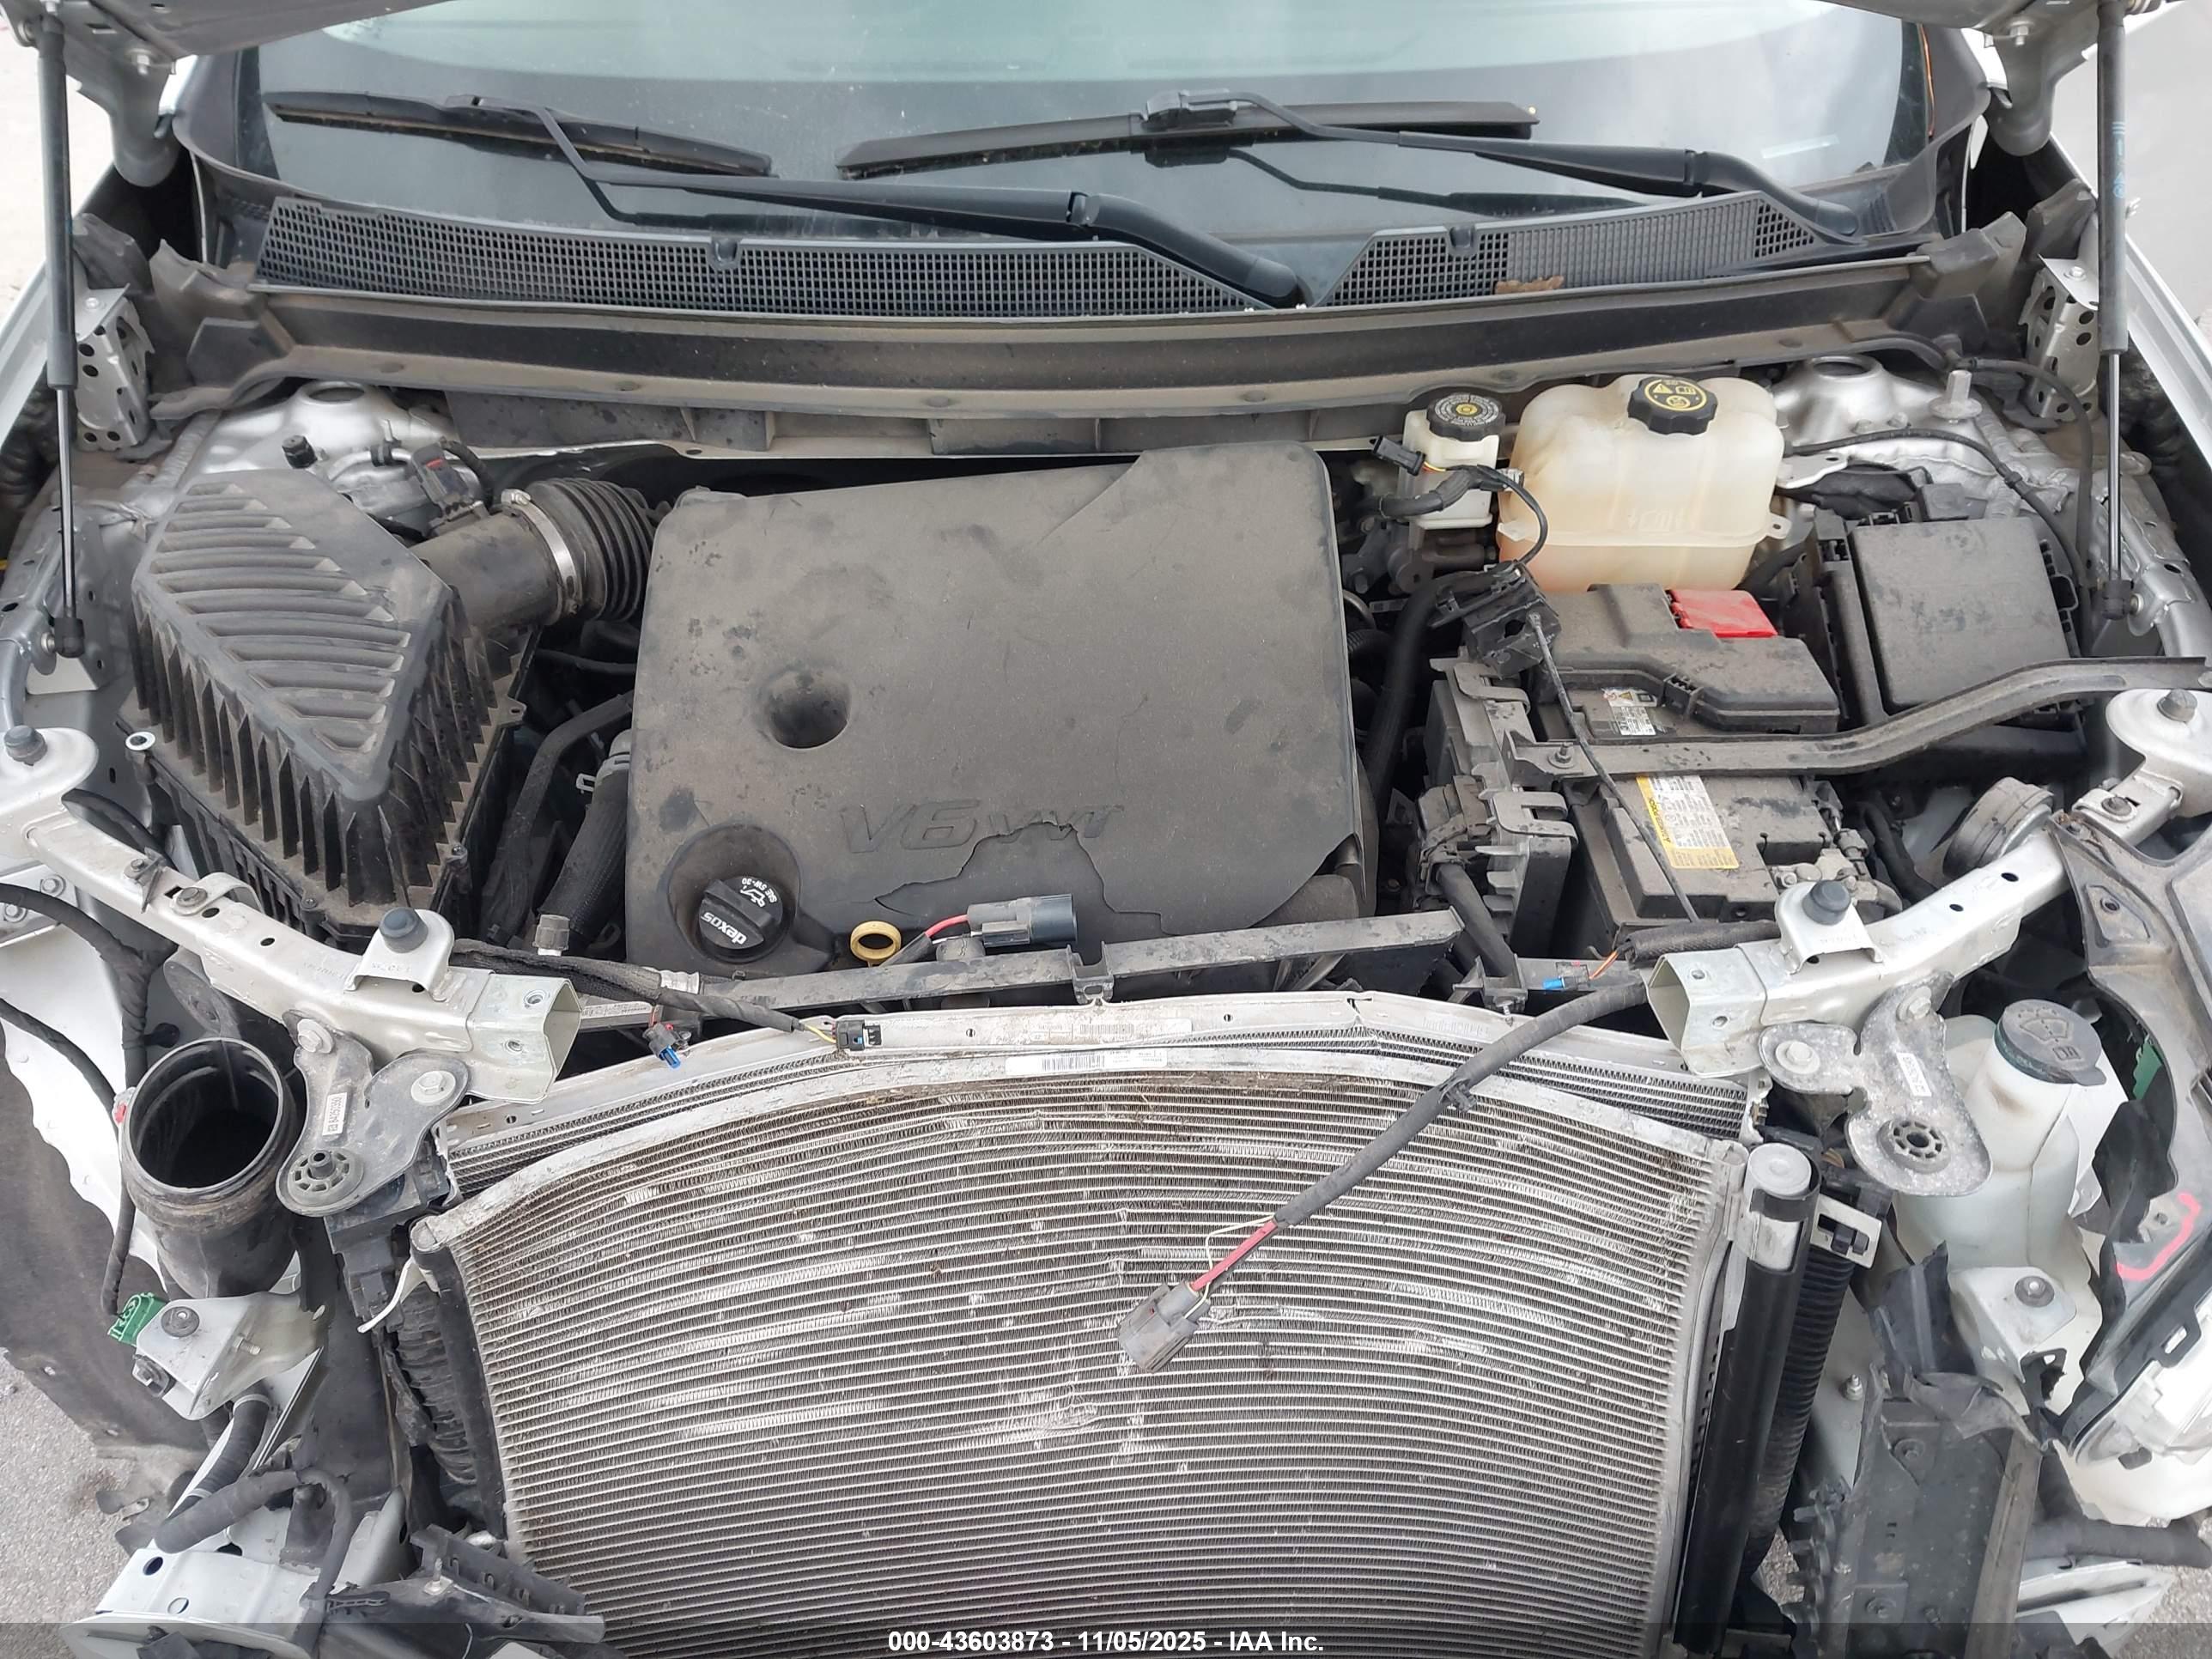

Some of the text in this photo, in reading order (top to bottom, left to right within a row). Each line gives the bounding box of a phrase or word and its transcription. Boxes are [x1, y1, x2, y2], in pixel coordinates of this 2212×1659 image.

[840, 799, 981, 854] V6
[741, 878, 778, 903] SAE 5W-30
[700, 911, 747, 945] dexos
